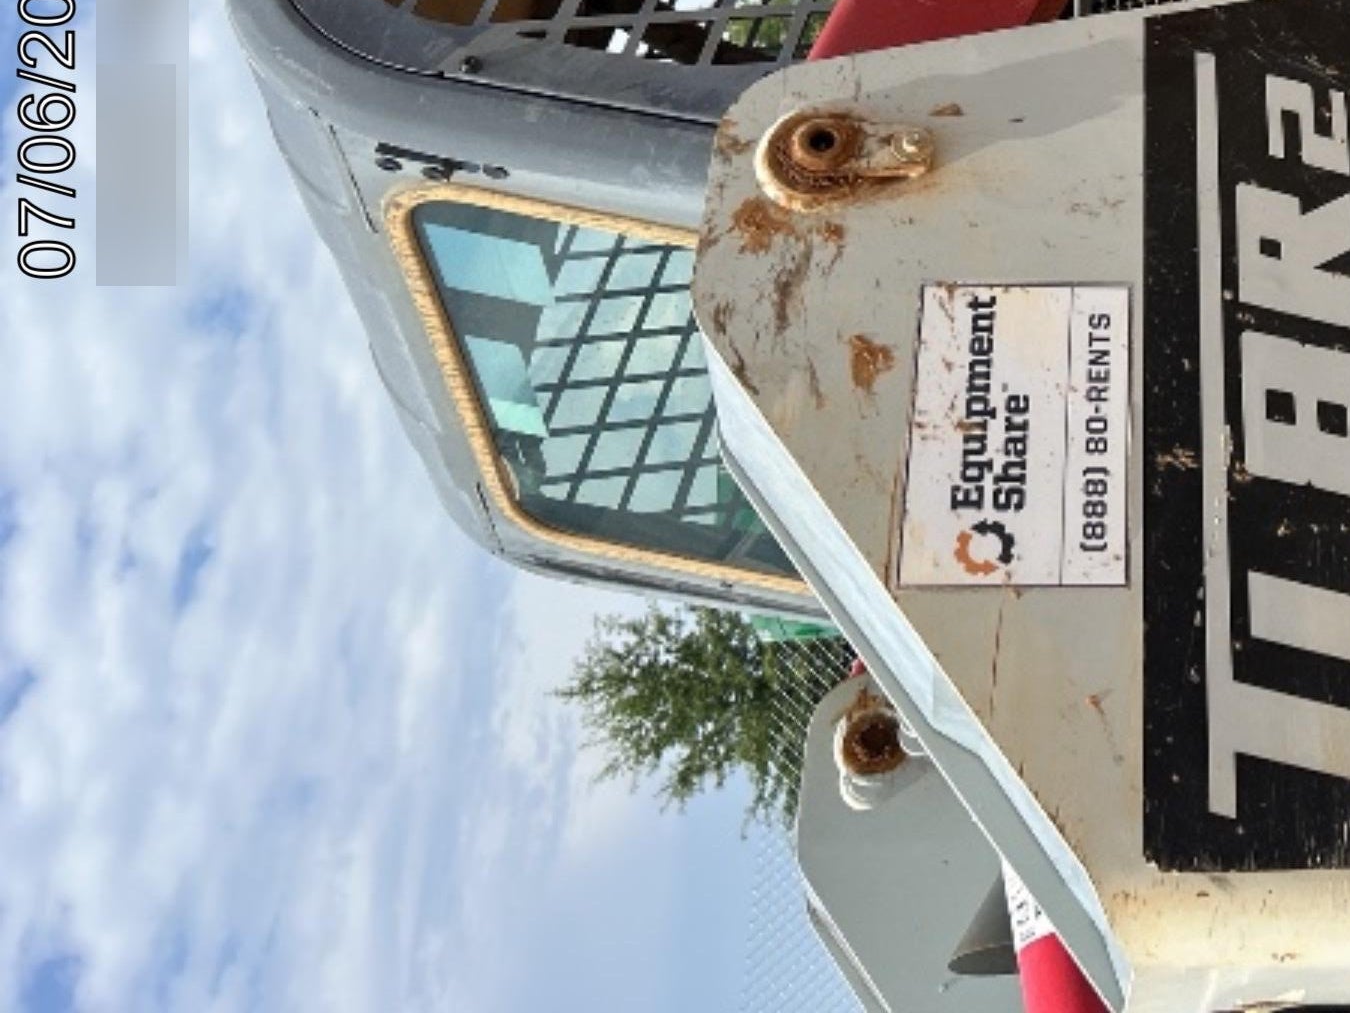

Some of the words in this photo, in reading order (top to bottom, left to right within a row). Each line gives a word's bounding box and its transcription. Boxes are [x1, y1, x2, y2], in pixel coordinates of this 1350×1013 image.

[951, 294, 998, 511] Equipment
[1085, 312, 1111, 455] 80-RENTS
[992, 393, 1030, 512] Share
[1079, 465, 1110, 553] (888)
